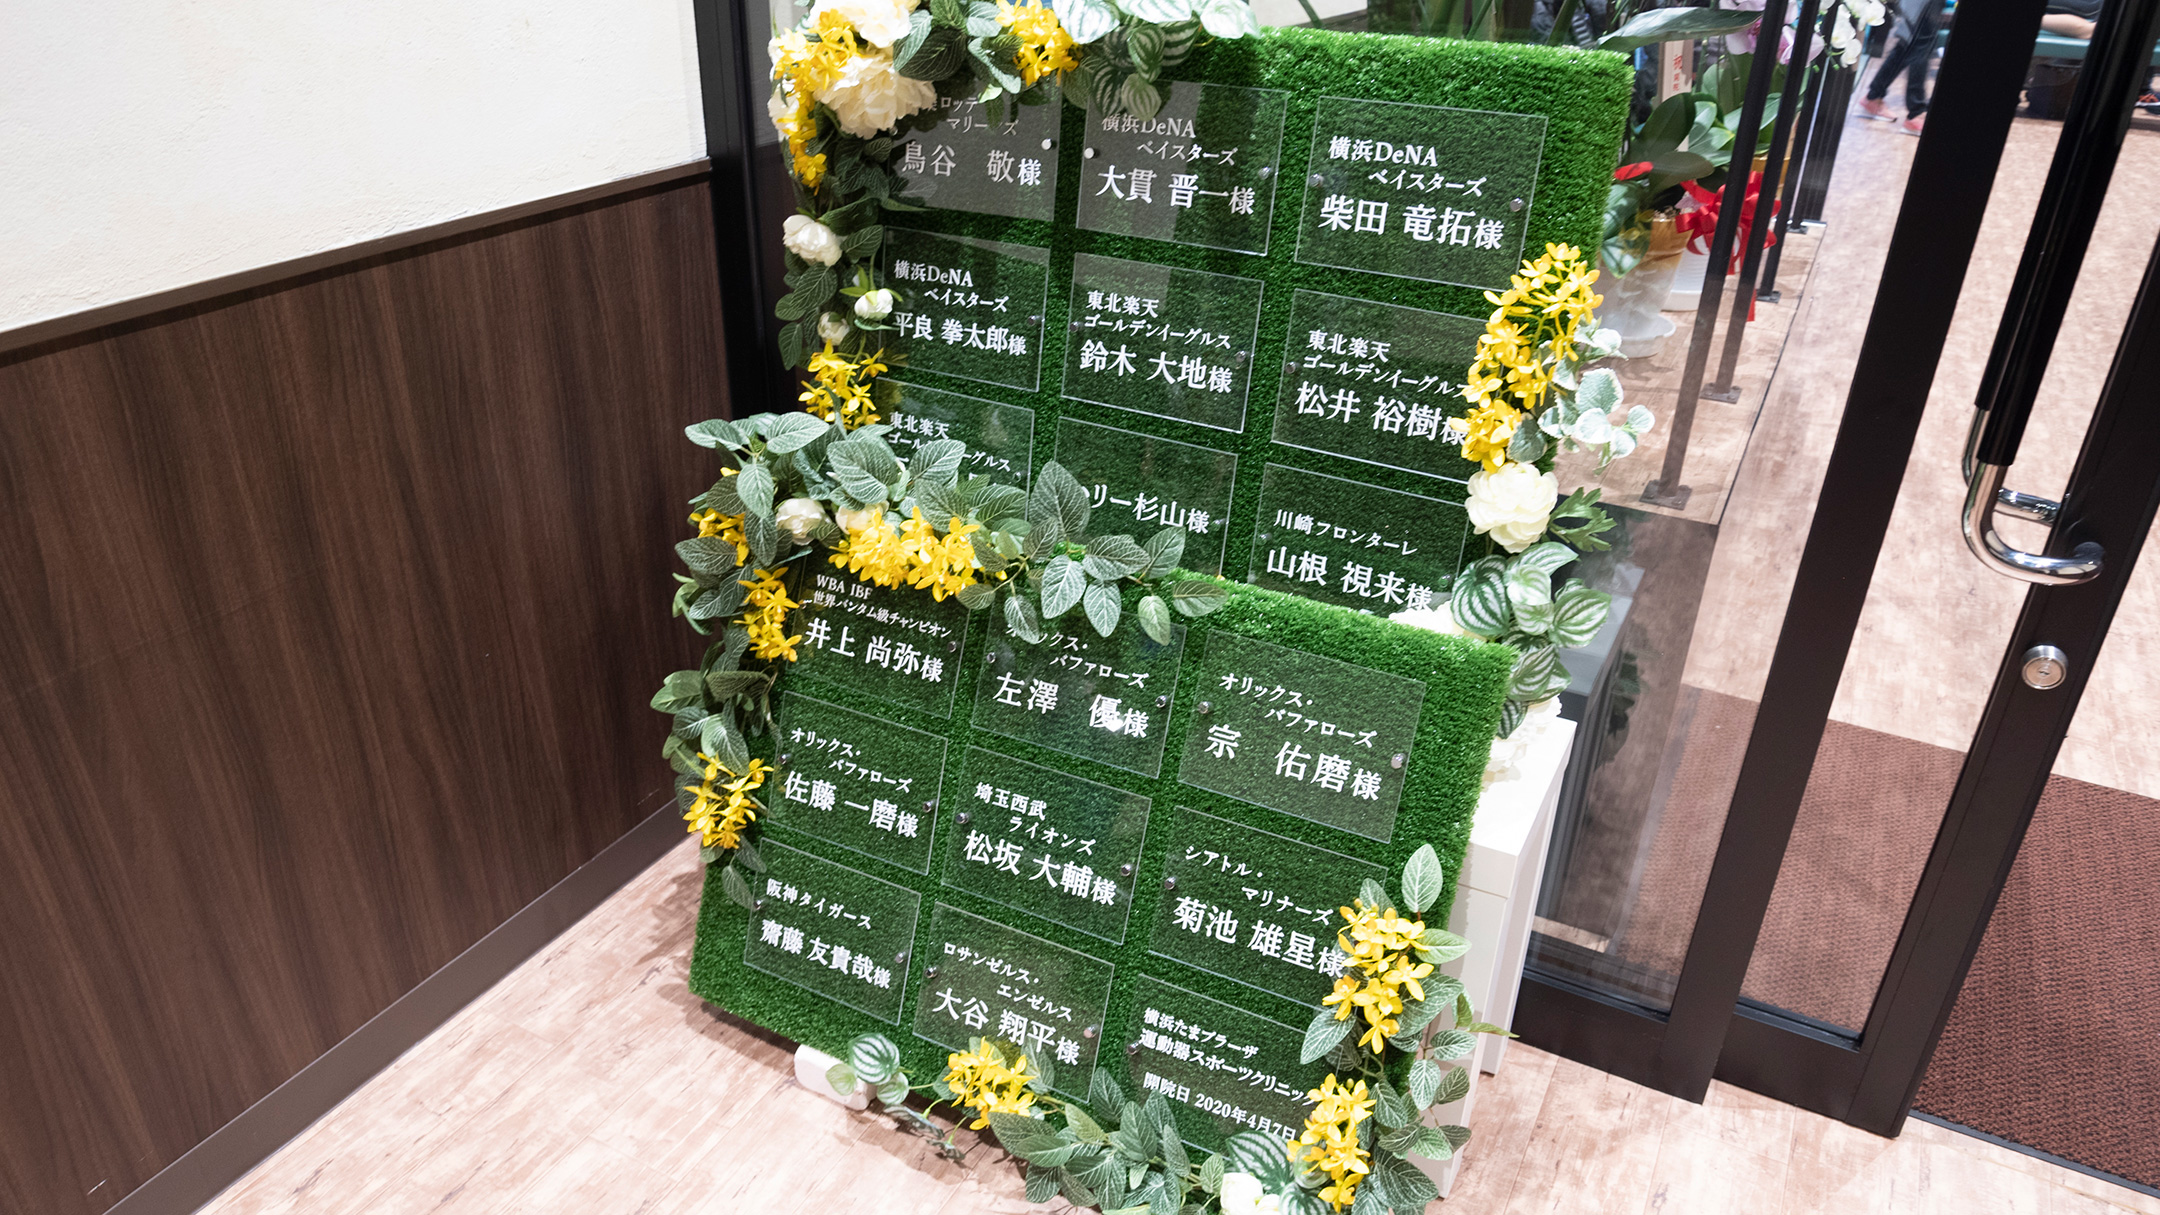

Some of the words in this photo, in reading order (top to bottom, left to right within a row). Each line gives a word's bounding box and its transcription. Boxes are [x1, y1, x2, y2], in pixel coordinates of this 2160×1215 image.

[946, 116, 1019, 136] マリーズ
[1102, 113, 1197, 139] 横浜DeNA
[902, 141, 956, 177] 鳥谷
[986, 150, 1042, 187] 敬様
[1137, 141, 1238, 166] ベイスターズ
[1328, 135, 1438, 167] 横浜DeNA
[1095, 164, 1157, 204] 大貫
[1168, 173, 1256, 215] 晋一様
[1368, 169, 1487, 197] ベイスターズ
[1318, 194, 1389, 235] 柴田
[1403, 203, 1504, 250] 竜拓様
[894, 259, 974, 288] 横浜DeNA
[924, 288, 1010, 313] ベイスターズ
[1085, 290, 1160, 318] 東北楽天
[893, 311, 934, 341] 平良
[941, 318, 1027, 356] 拳太郎様
[1084, 313, 1231, 350] ゴールデンイーグルス
[1306, 329, 1391, 363] 東北楽天
[1079, 338, 1137, 377] 鈴木
[1146, 351, 1233, 394] 大地様
[1294, 380, 1361, 424] 松井
[889, 411, 950, 440] 東北楽天
[888, 432, 1011, 472] ゴールーグルス
[1273, 509, 1418, 556] 川崎フロンターレ
[816, 574, 845, 594] WBA
[850, 583, 873, 600] IBF
[1266, 546, 1328, 587] 山根
[1340, 561, 1434, 613] 視来様
[813, 590, 952, 639] 世界バンタム級チャンピオン
[803, 617, 856, 658] 井上
[865, 635, 944, 683] 尚弥様
[1049, 654, 1149, 689] バファローズ
[1218, 672, 1313, 708] オリックス・
[992, 671, 1059, 715] 左澤
[1088, 693, 1150, 739] 優様
[790, 727, 861, 758] オリックス・
[1264, 708, 1378, 749] バファローズ
[828, 759, 913, 794] バファローズ
[1204, 724, 1242, 760] 宗
[1274, 741, 1382, 801] 佑磨様
[784, 770, 837, 812] 佐藤
[844, 798, 919, 839] 一磨様
[974, 781, 1048, 821] 埼玉西武
[1009, 816, 1097, 856] ライオンズ
[963, 829, 1024, 876] 松坂
[1028, 853, 1117, 906] 大輔様
[1185, 845, 1263, 878] シアトル・
[766, 878, 872, 930] 阪神タイガース
[1241, 886, 1334, 926] マリナーズ
[1172, 896, 1239, 944] 菊池
[1247, 919, 1346, 978] 雄星様
[806, 936, 892, 990] 友貴哉様
[944, 942, 1040, 985] ロサンゼルス・
[996, 984, 1072, 1022] エンゼルス
[932, 987, 989, 1030] 大谷
[997, 1008, 1081, 1067] 翔平様
[1143, 1006, 1260, 1060] 横浜たまプラーザ
[1143, 1071, 1191, 1104] 開院日
[1194, 1092, 1297, 1141] 2020年4月7日
